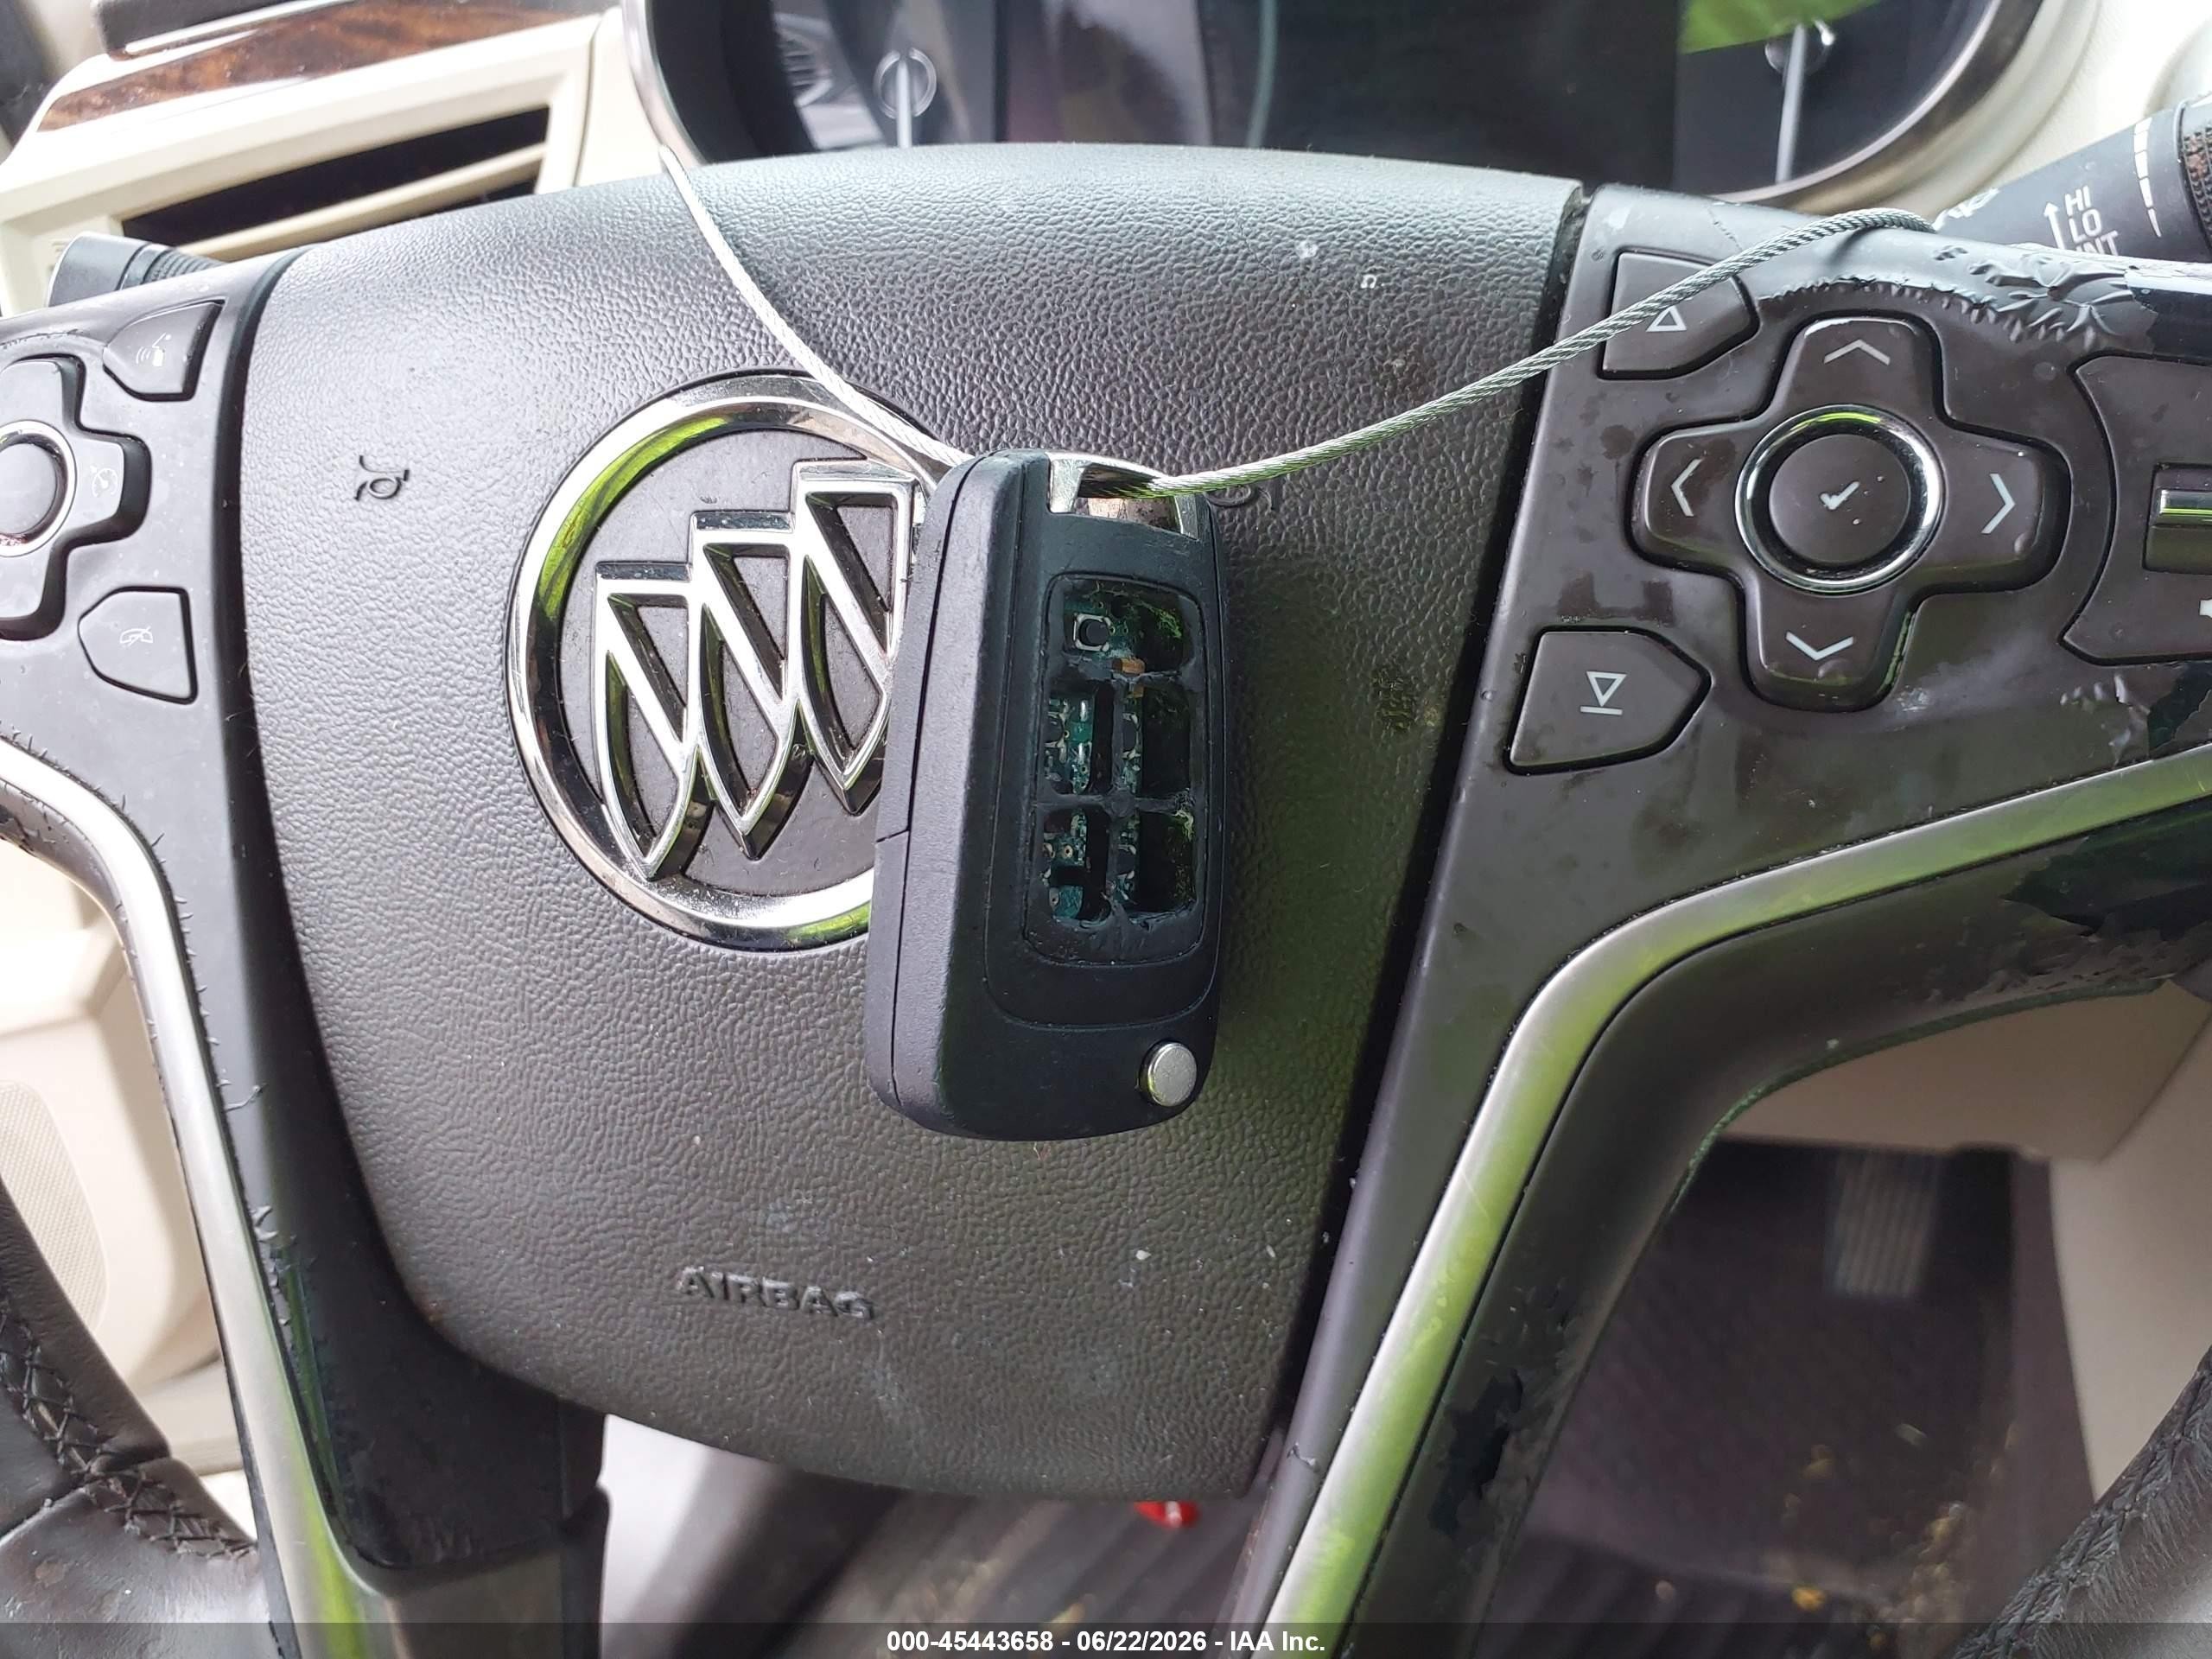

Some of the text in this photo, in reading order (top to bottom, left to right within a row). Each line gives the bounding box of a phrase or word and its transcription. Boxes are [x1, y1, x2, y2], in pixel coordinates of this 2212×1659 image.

[2064, 184, 2091, 217] HI
[2069, 208, 2102, 244] LO
[675, 1265, 875, 1320] AIRBAG
